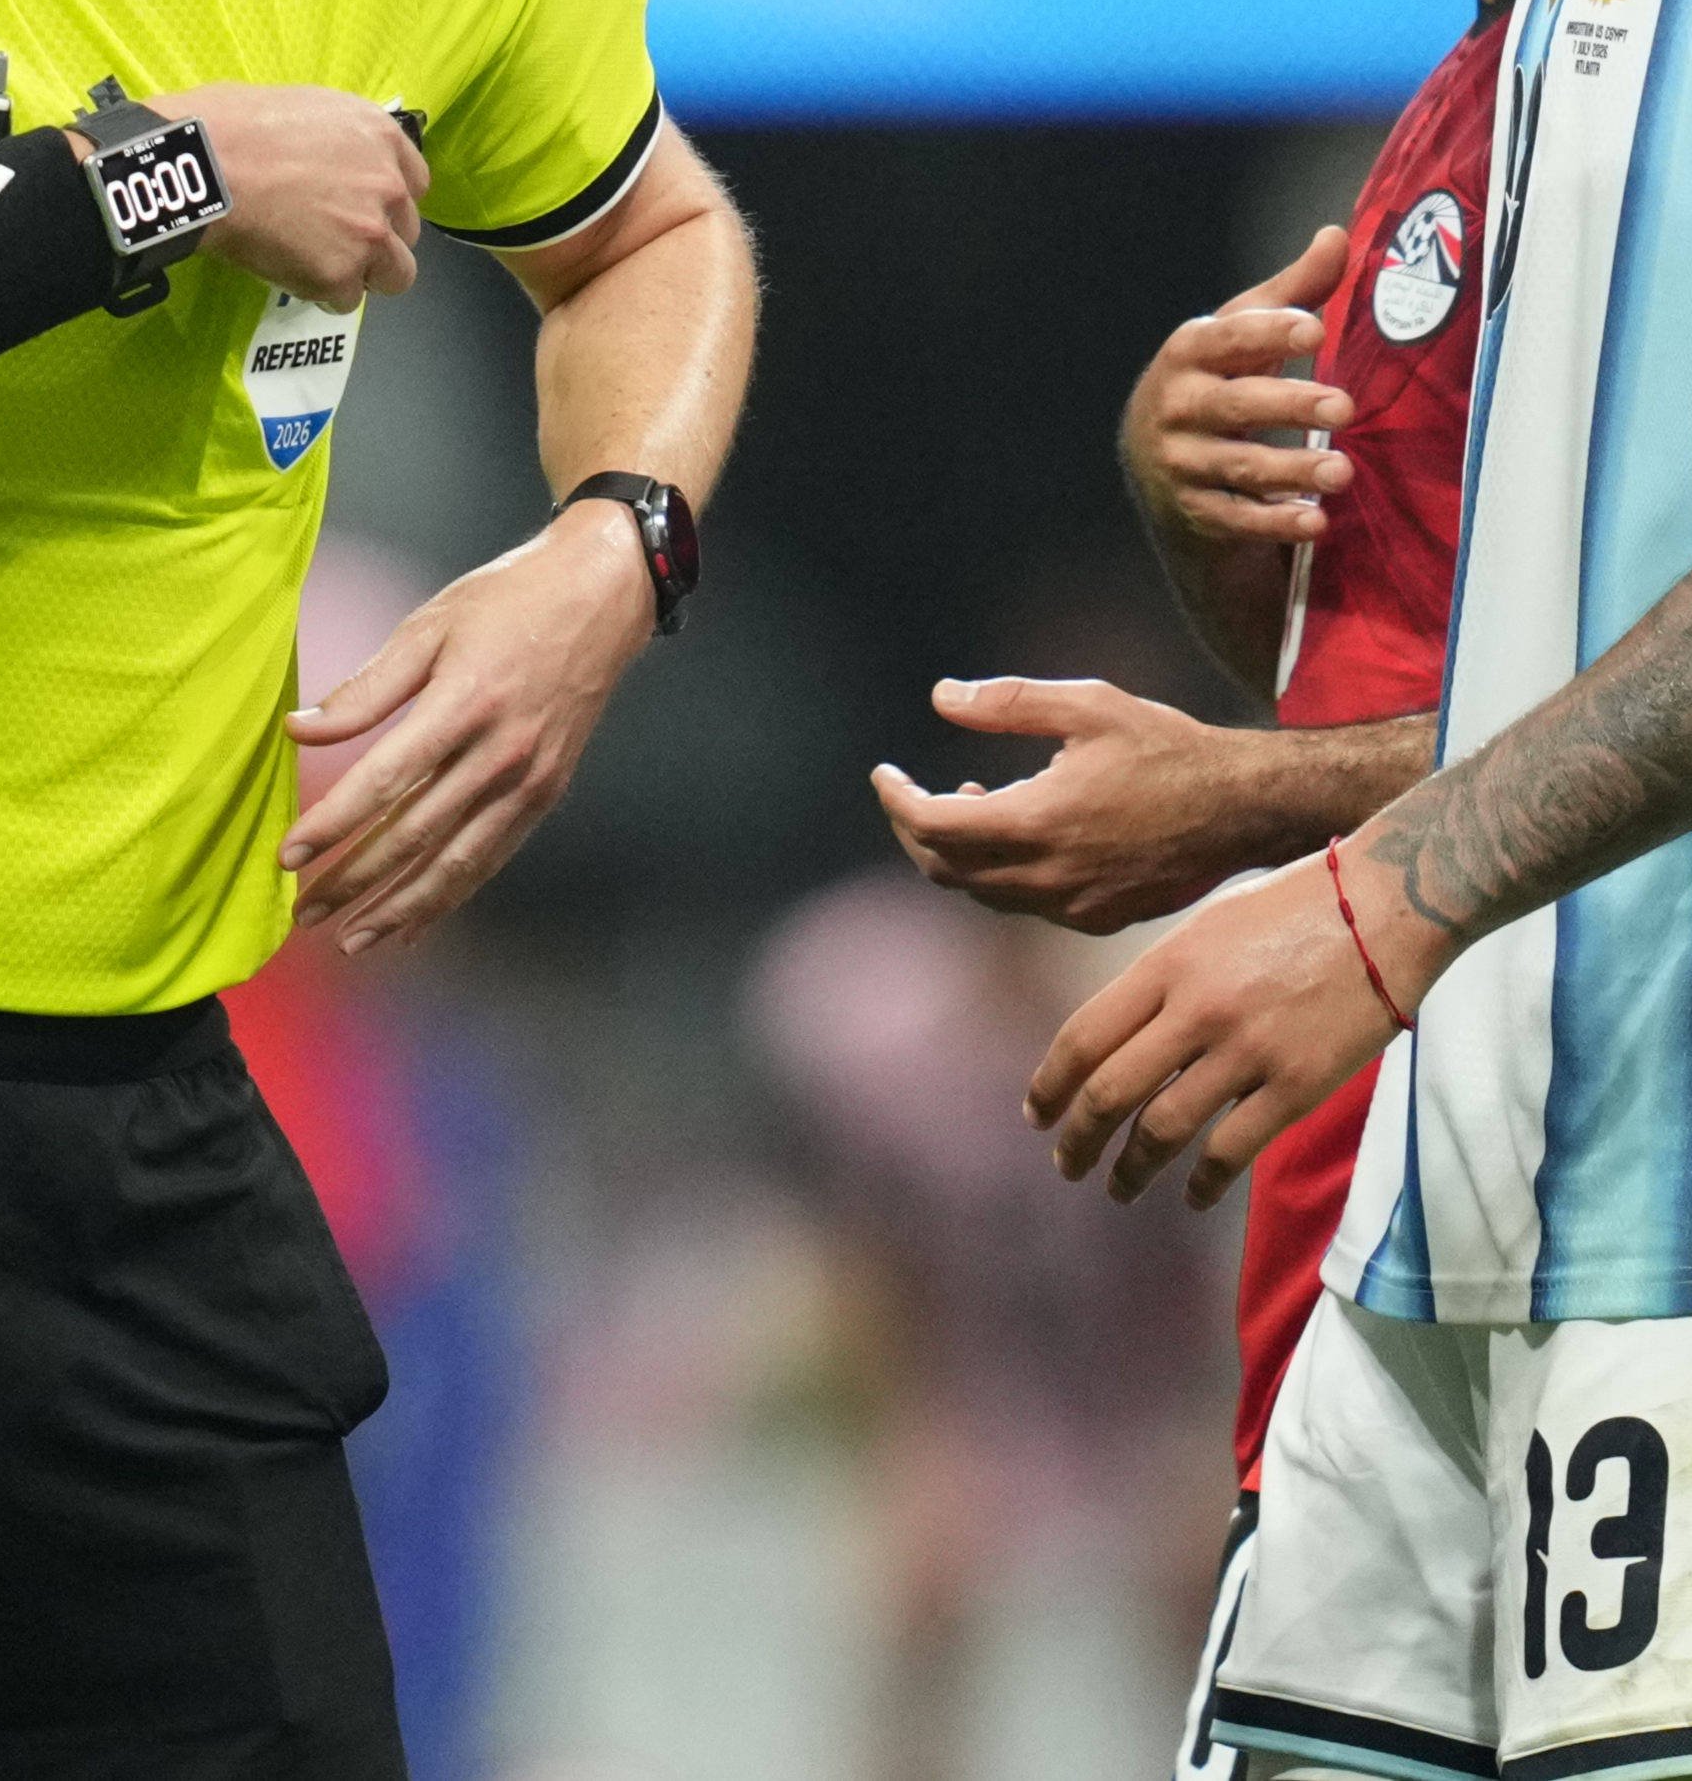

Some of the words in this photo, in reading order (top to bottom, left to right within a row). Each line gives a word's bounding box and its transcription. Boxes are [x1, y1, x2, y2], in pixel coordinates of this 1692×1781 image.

[106, 152, 208, 230] 00:00
[251, 334, 345, 373] REFEREE
[273, 420, 311, 449] 2026
[1524, 1415, 1669, 1679] 13
